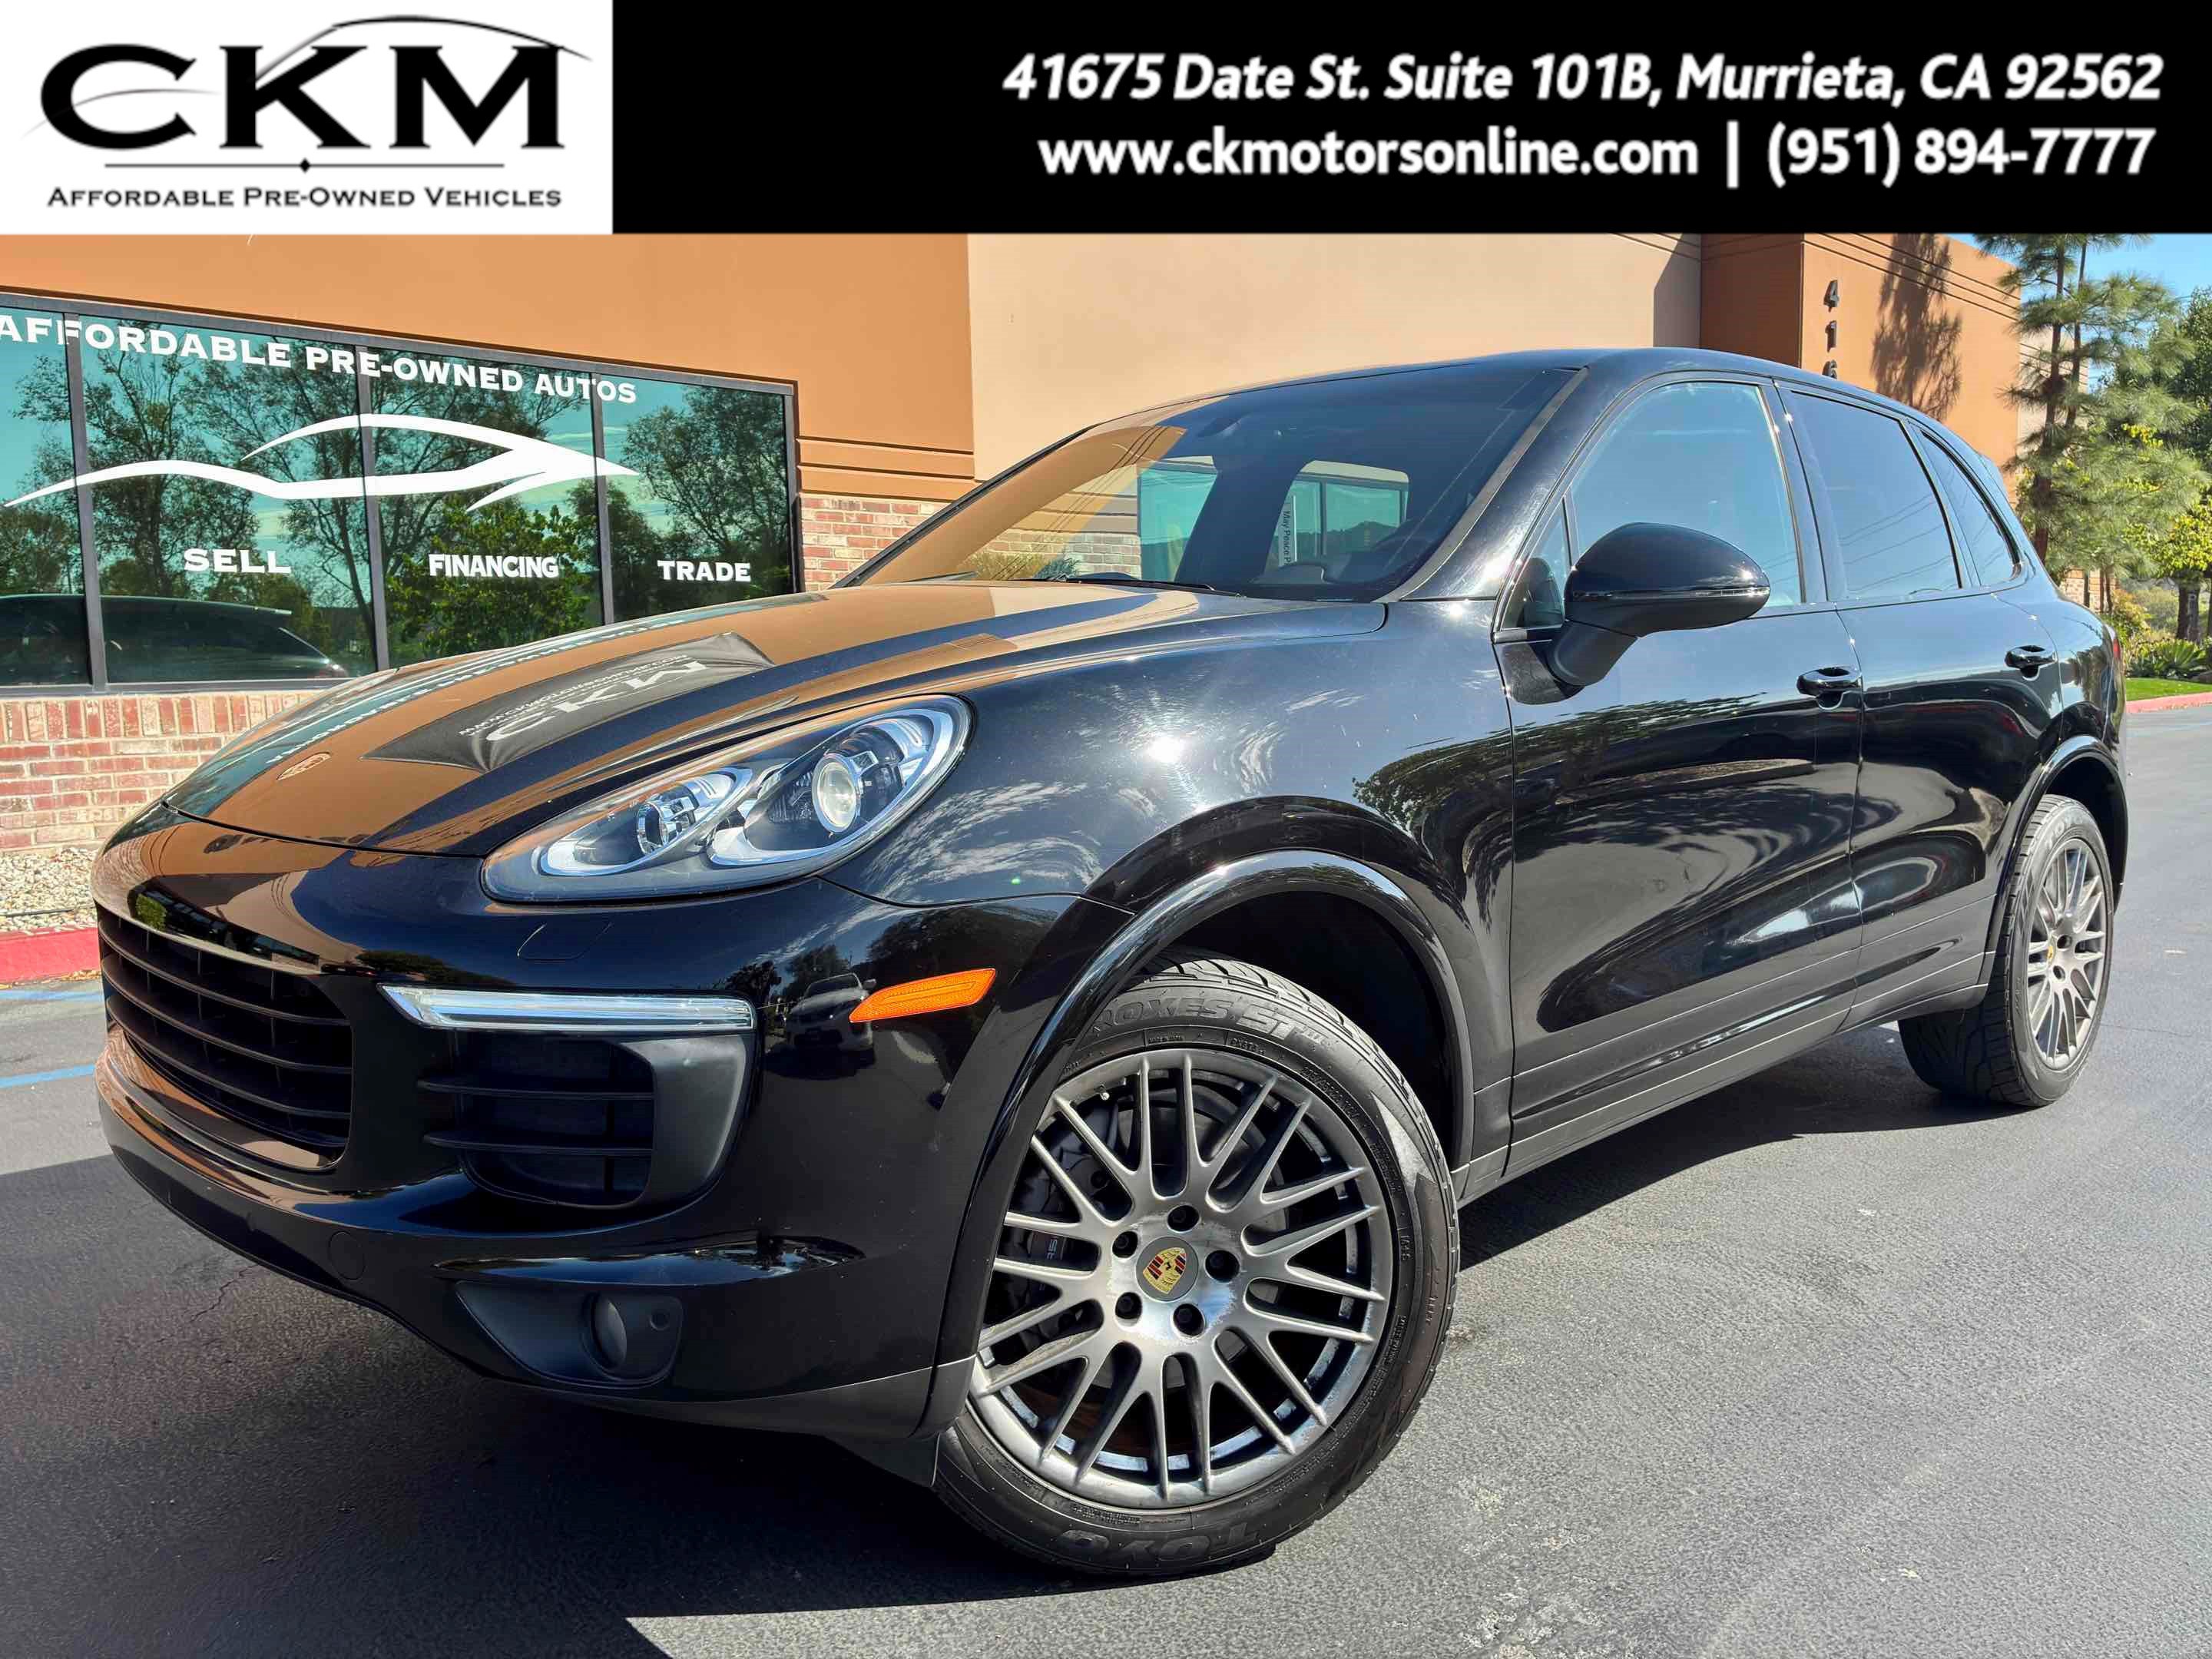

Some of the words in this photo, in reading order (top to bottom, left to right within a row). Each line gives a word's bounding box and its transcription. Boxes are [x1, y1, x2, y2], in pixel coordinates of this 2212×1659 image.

[0, 317, 291, 369] AFFORDABLE
[306, 346, 524, 393] PRE-OWNED
[534, 373, 637, 403] AUTOS
[184, 548, 292, 575] SELL
[428, 553, 559, 579] FINANCING
[657, 559, 751, 582] TRADE
